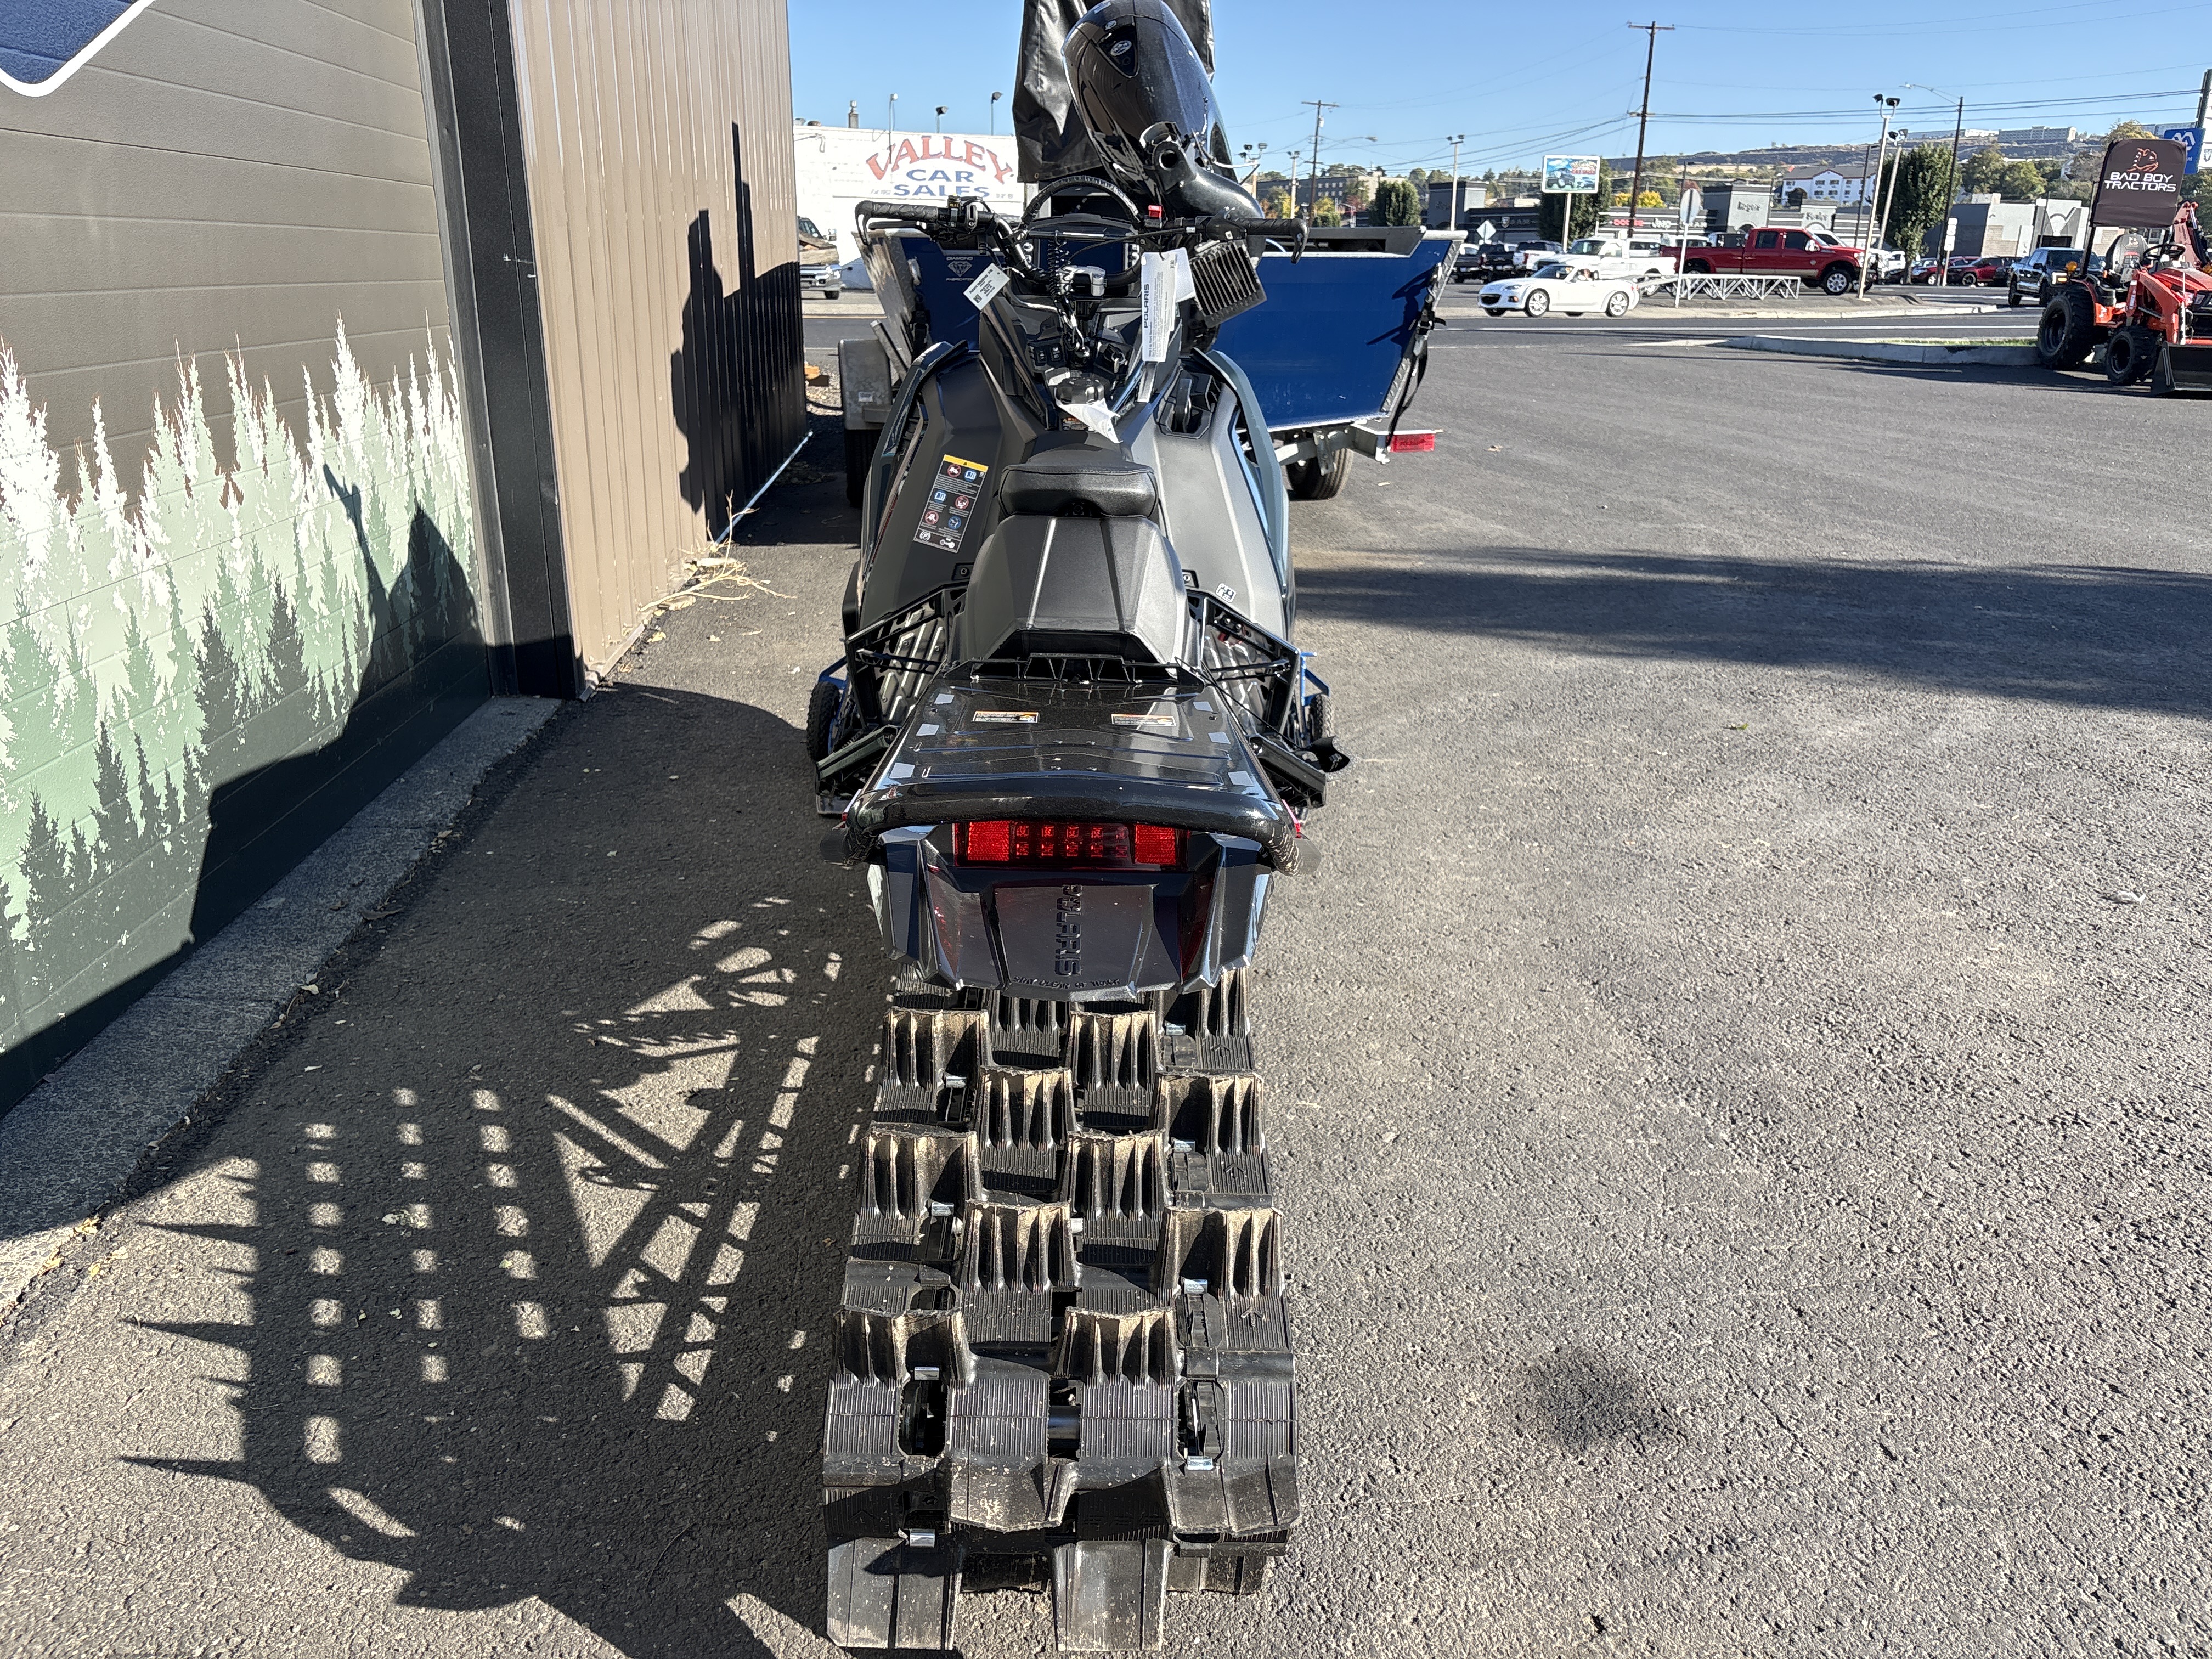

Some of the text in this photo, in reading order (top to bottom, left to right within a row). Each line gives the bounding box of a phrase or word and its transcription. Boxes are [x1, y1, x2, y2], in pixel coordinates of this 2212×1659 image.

[866, 135, 1013, 184] VALLEY
[906, 169, 974, 183] CAR
[2110, 172, 2174, 182] BAD BOY
[893, 184, 990, 198] SALES
[2104, 180, 2177, 193] TRACTORS
[1054, 884, 1083, 977] POLARIS
[1013, 975, 1038, 985] STAY
[1039, 978, 1070, 989] CLEAR
